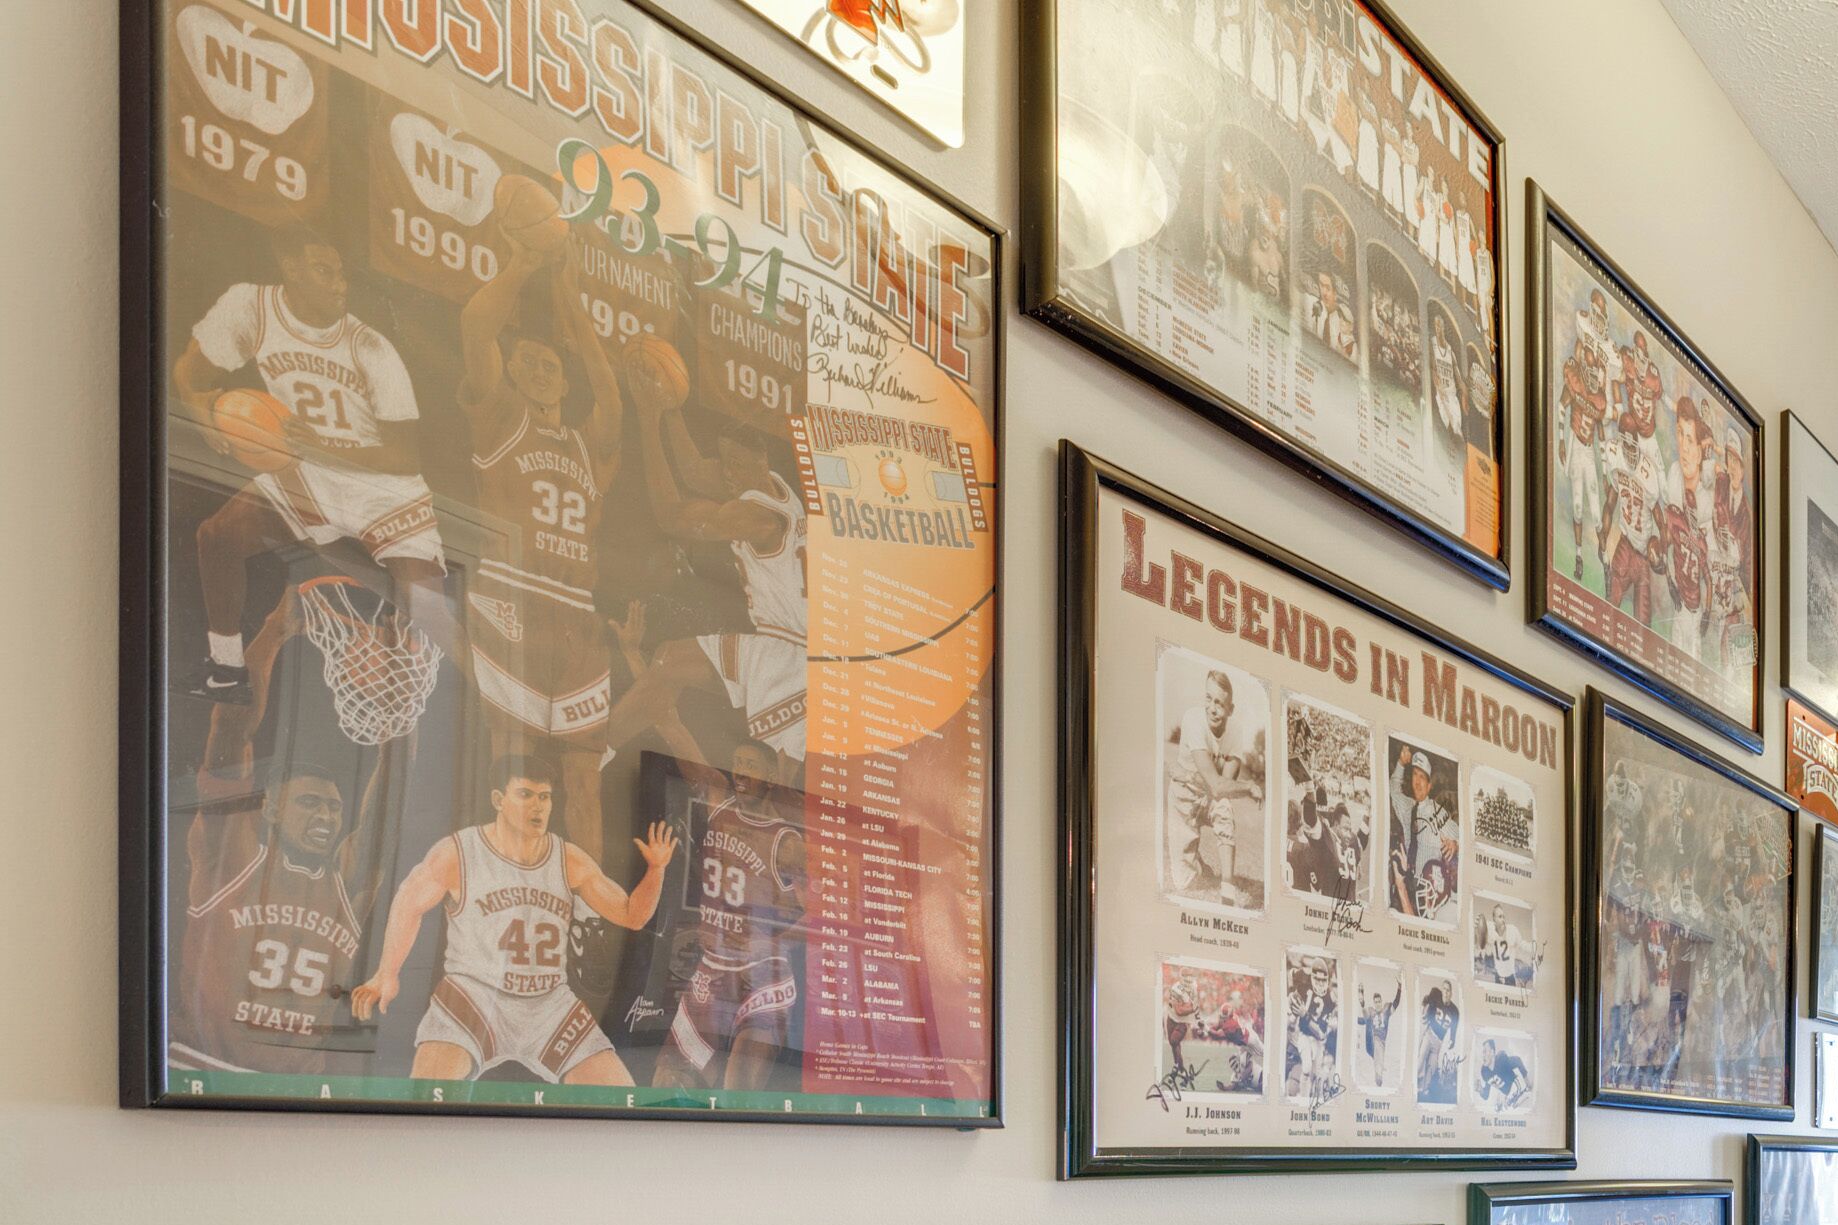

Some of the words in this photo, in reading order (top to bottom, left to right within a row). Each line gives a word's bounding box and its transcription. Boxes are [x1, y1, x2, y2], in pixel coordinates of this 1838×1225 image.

[206, 34, 288, 105] NIT
[1358, 16, 1490, 193] STATE
[181, 115, 307, 201] 1979
[415, 140, 479, 200] NIT
[246, 0, 787, 240] SISSIPPI
[800, 147, 971, 384] STATE
[391, 207, 498, 282] 1990
[556, 137, 787, 325] 93-94
[584, 243, 672, 310] URNAMENT
[710, 303, 802, 372] CHAMPIONS
[725, 360, 792, 414] 1991
[293, 380, 352, 430] 21
[805, 403, 909, 451] MISSISSIPPI
[909, 421, 958, 472] STATE
[790, 418, 822, 512] BULLDOGS
[958, 445, 986, 530] BULLDOGS
[532, 480, 587, 534] 32
[826, 491, 976, 549] BASKETBALL
[536, 531, 589, 562] STATE
[1121, 508, 1358, 684] LEGENDS
[1370, 641, 1411, 709] IN
[1421, 651, 1558, 770] MAROON
[821, 780, 836, 791] Jan.
[863, 790, 901, 805] ARKANSAS
[863, 774, 894, 788] GEORGIA
[1810, 769, 1838, 801] STATE
[820, 796, 836, 807] Jan.
[862, 806, 899, 820] KENTUCKY
[820, 813, 835, 823] Jan.
[870, 824, 885, 833] LSU
[821, 845, 836, 854] Feb.
[927, 865, 942, 874] CITY
[822, 861, 837, 871] Feb.
[1475, 853, 1490, 865] 1941
[1491, 858, 1503, 870] SEC
[703, 860, 746, 907] 33
[822, 877, 837, 887] Feb.
[864, 885, 894, 897] FLORIDA
[895, 890, 913, 900] TECH
[822, 893, 837, 903] Feb.
[822, 910, 837, 919] Feb.
[1180, 912, 1209, 928] ALLYN
[231, 905, 359, 960] MISSISSIPPI
[498, 918, 561, 967] 42
[821, 926, 837, 936] Feb.
[864, 932, 895, 943] AUBURN
[248, 939, 330, 997] 35
[821, 943, 837, 952] Feb.
[873, 950, 893, 959] South
[822, 958, 836, 968] Feb.
[864, 964, 878, 973] LSU
[1493, 940, 1510, 962] 12
[503, 971, 561, 994] STATE
[821, 975, 837, 984] Mar.
[864, 980, 899, 990] ALABAMA
[821, 991, 837, 1000] Mar.
[235, 1000, 316, 1036] STATE
[821, 1007, 837, 1017] Mar.
[838, 1009, 856, 1018] 10-13
[872, 1011, 886, 1021] SEC
[888, 1013, 926, 1024] Tournament
[1206, 1107, 1241, 1120] JOHNSON
